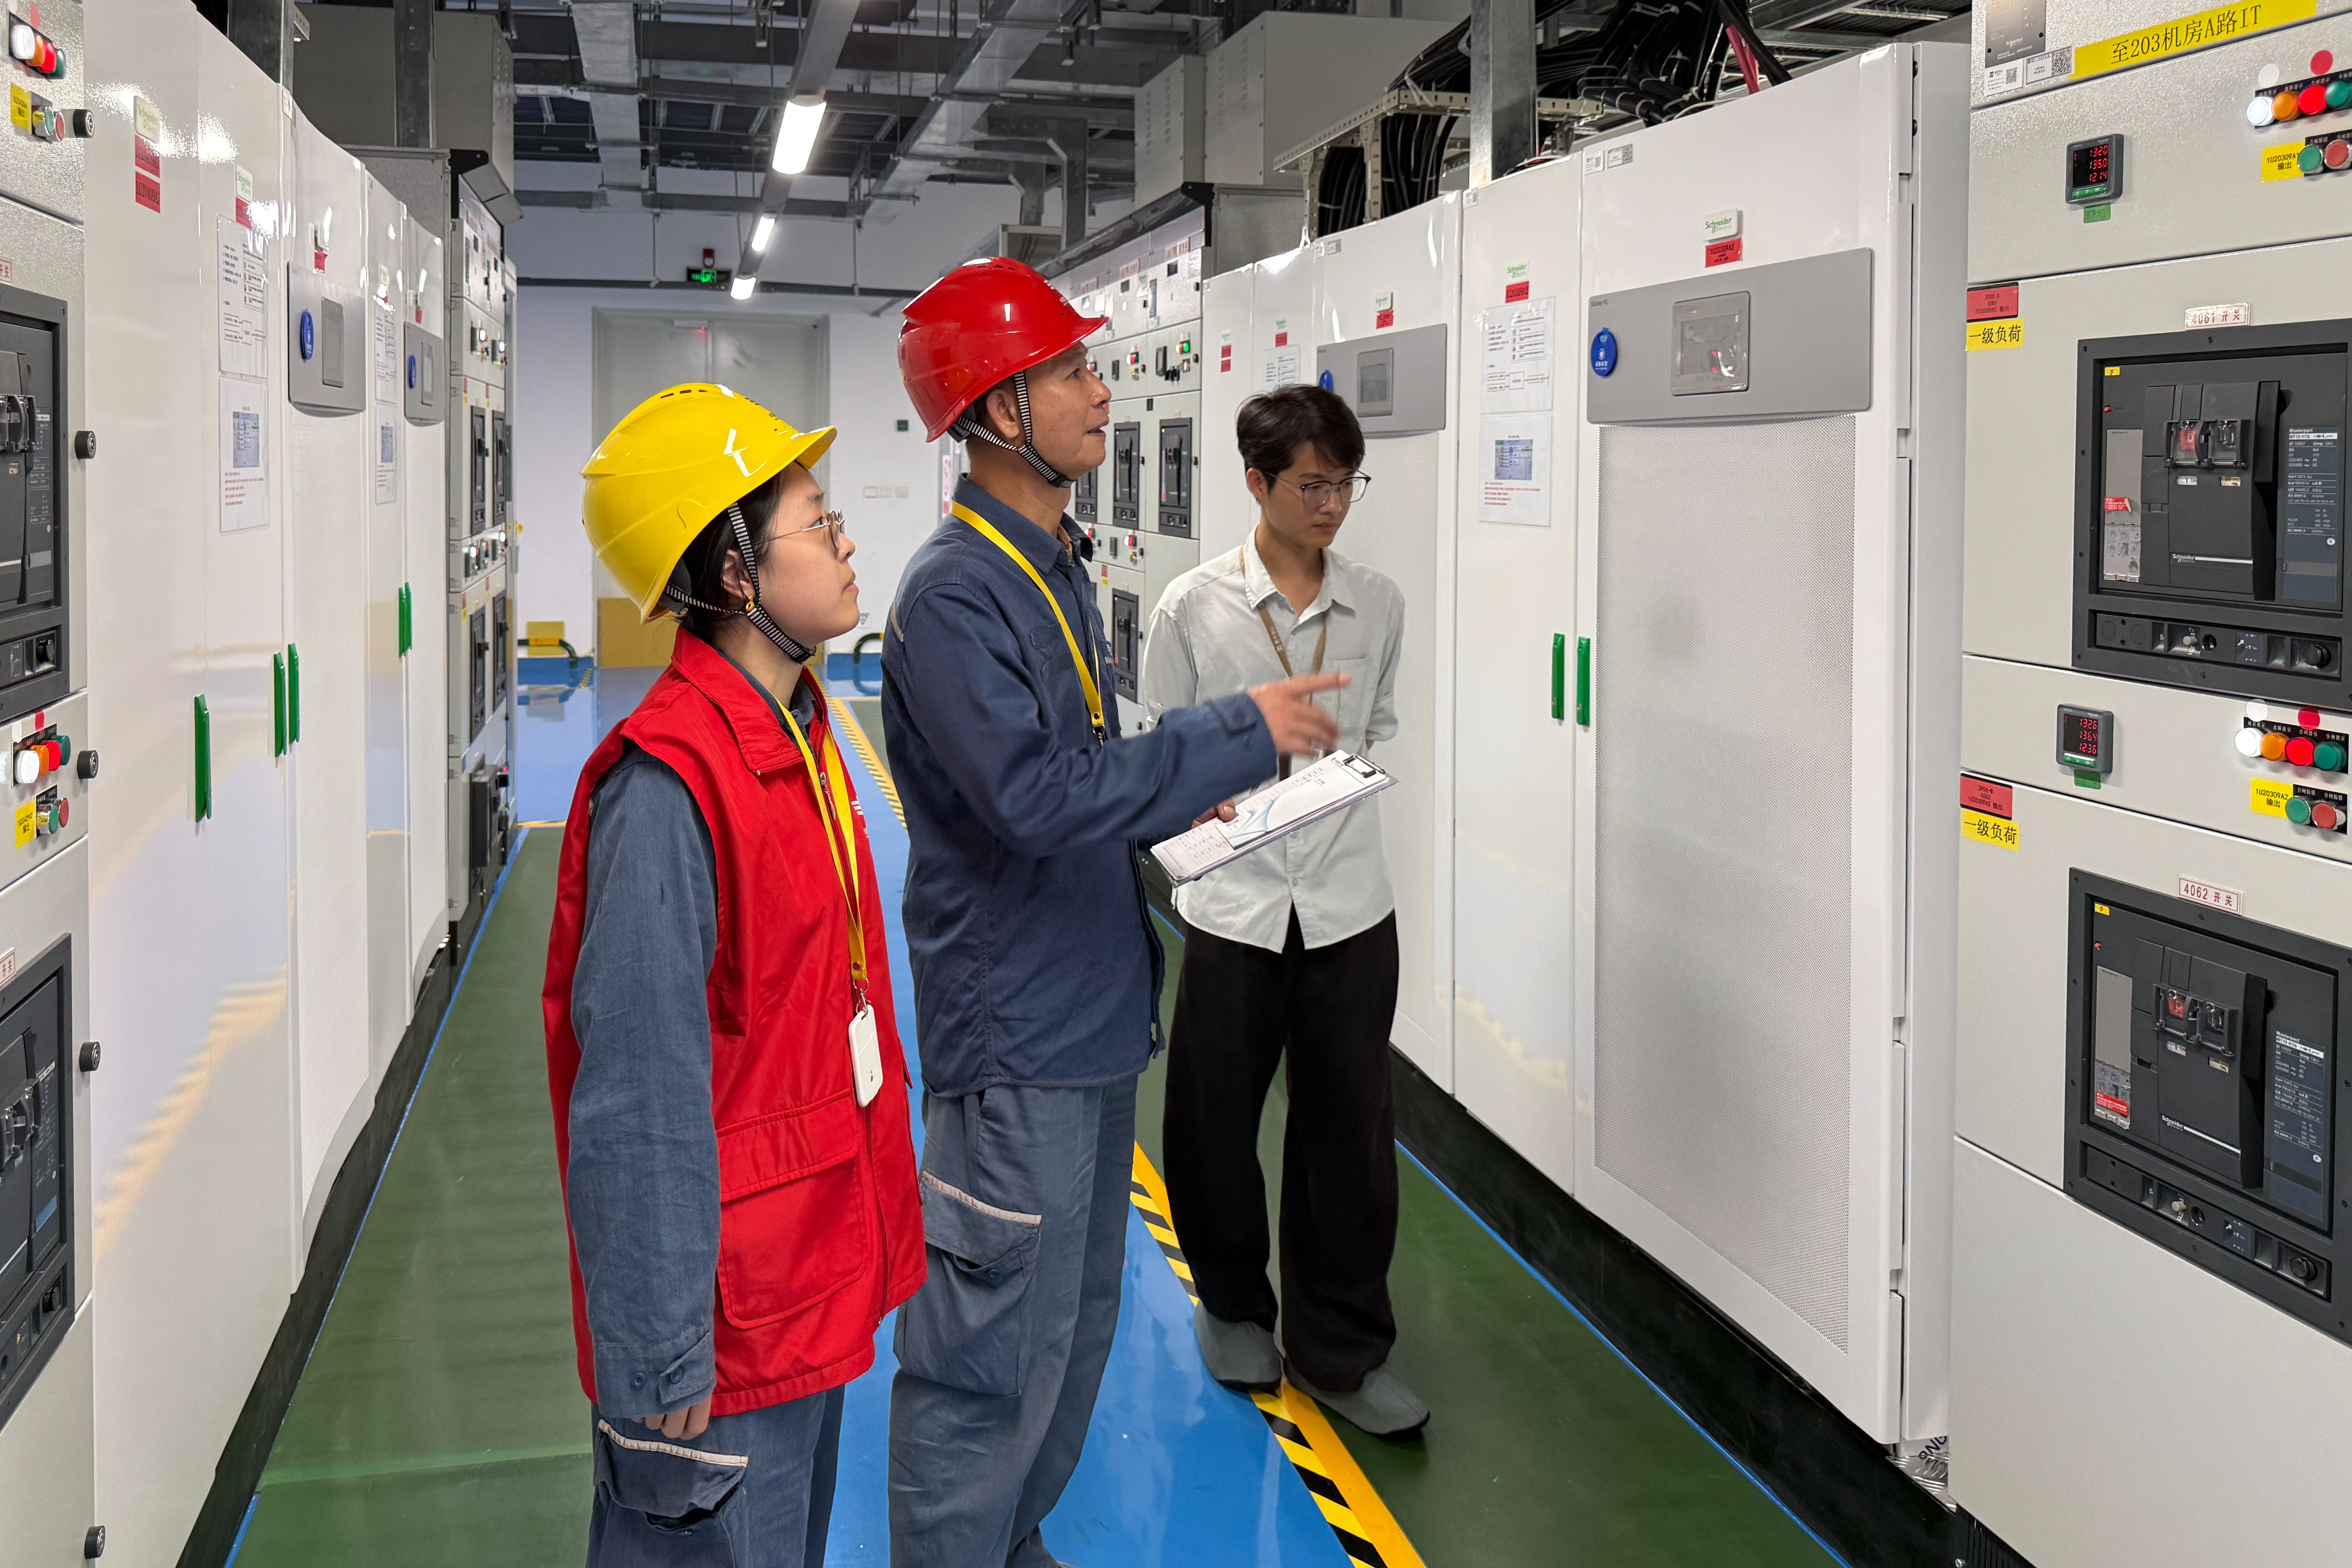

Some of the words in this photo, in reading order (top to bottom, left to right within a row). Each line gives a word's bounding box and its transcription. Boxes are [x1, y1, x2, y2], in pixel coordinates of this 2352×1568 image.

[2111, 5, 2261, 64] 至203机房A路IT
[2278, 161, 2292, 170] 输出
[1706, 218, 1732, 233] Schneider
[1969, 324, 2021, 344] 一级负荷
[2172, 554, 2194, 562] Schneider
[2080, 719, 2097, 730] 1326
[2079, 743, 2097, 754] 1236
[2256, 788, 2288, 800] 1U20309A2
[2266, 798, 2280, 808] 输出
[1964, 819, 2017, 845] 一级负荷
[2184, 883, 2208, 900] 4062
[2214, 891, 2232, 906] 开关
[2, 959, 12, 978] 开关
[2162, 1115, 2184, 1128] Schneider
